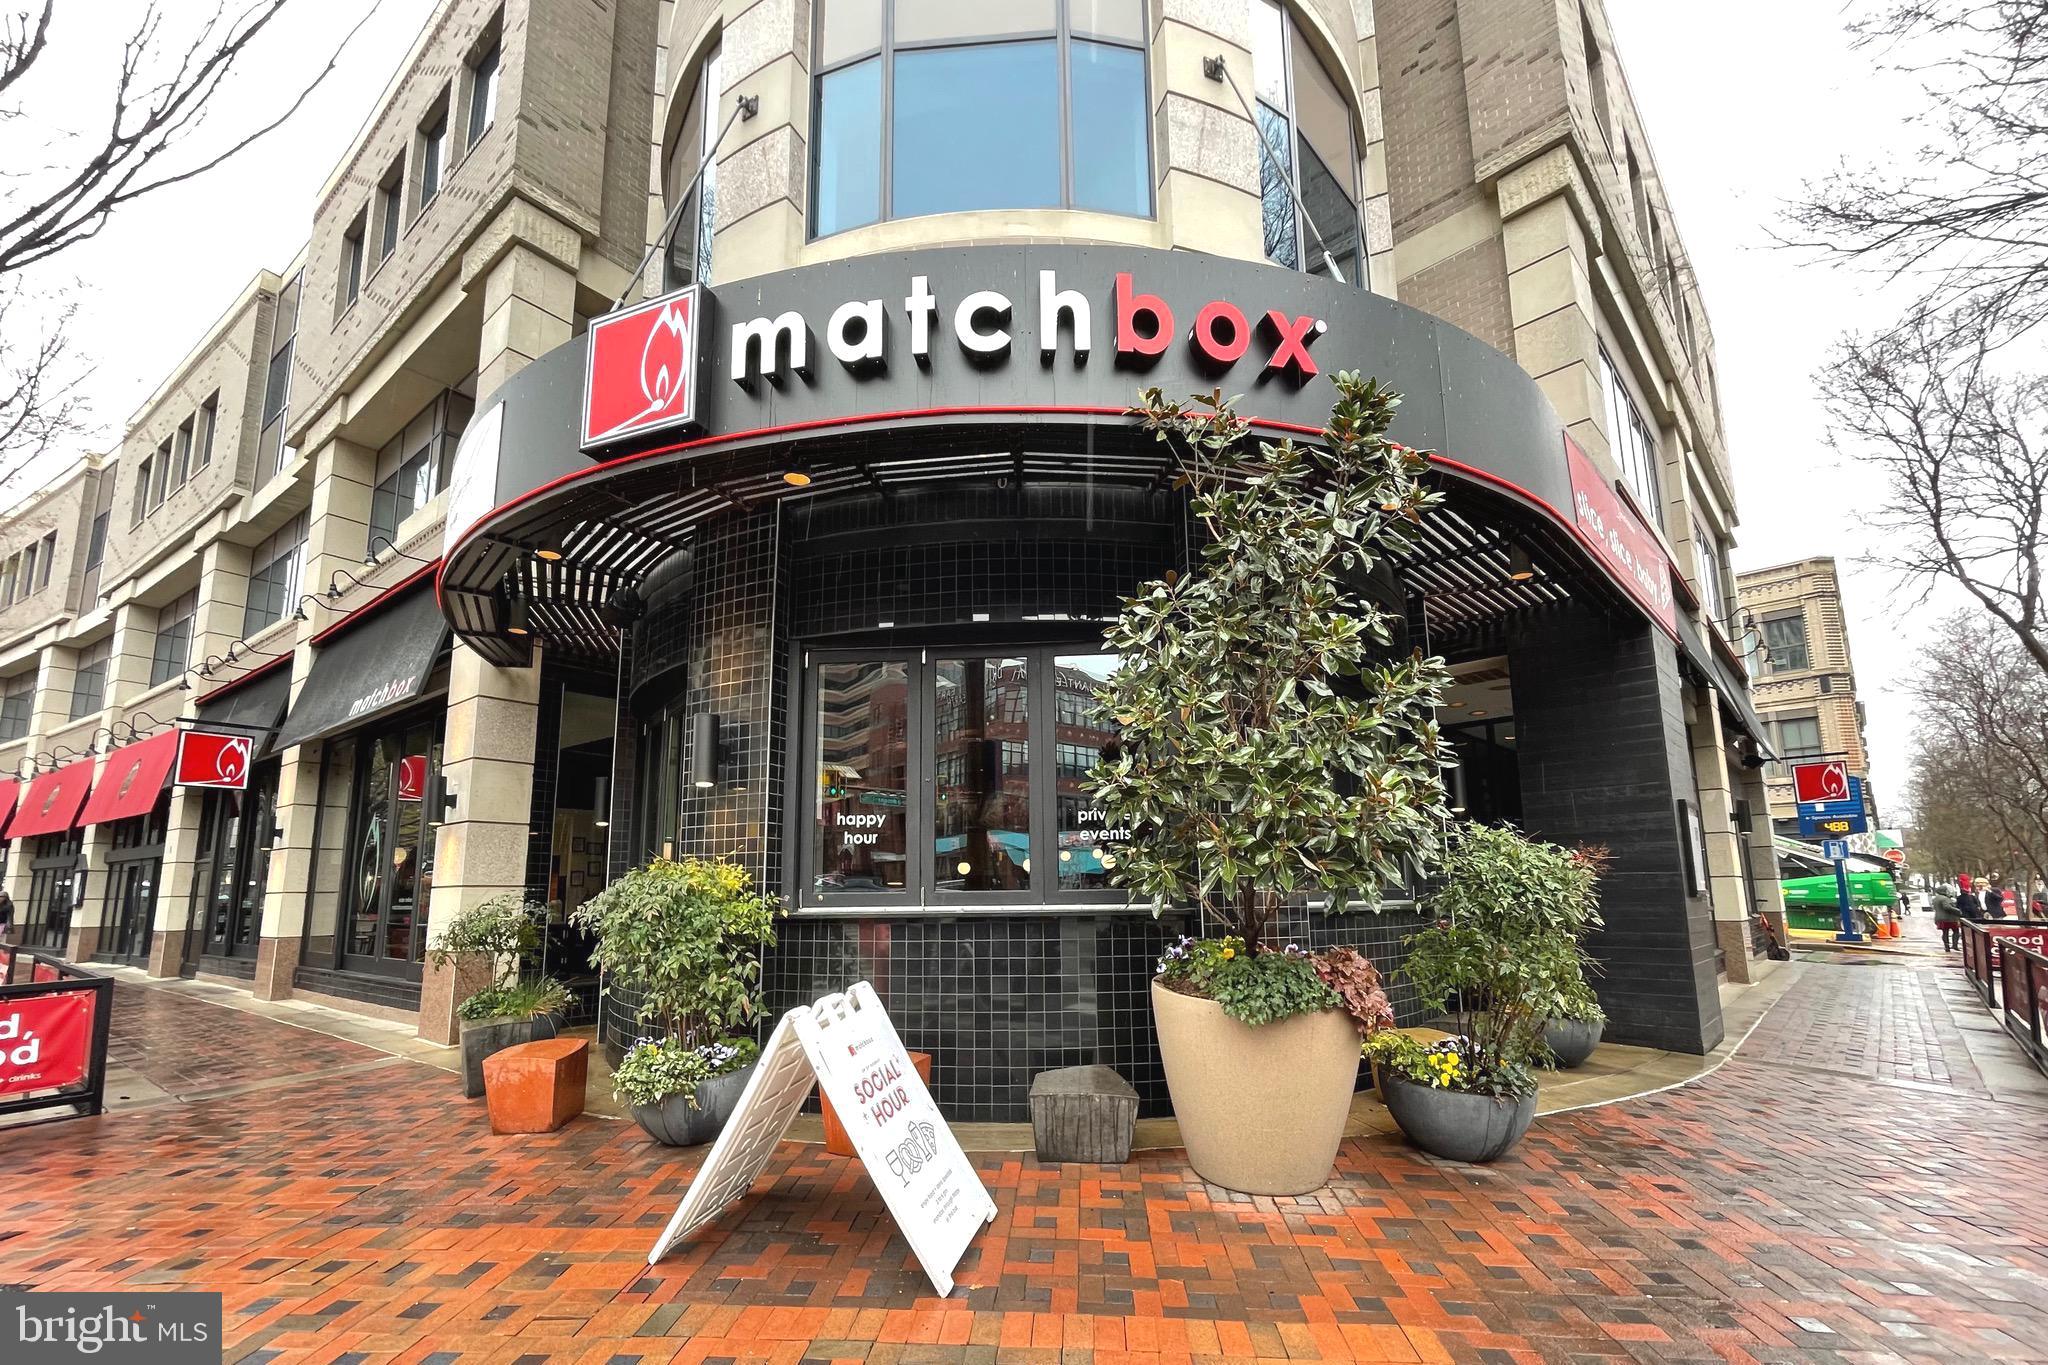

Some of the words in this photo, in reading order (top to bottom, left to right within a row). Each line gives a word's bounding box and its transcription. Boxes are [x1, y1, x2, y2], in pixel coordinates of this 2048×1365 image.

[731, 270, 1327, 384] matchbox
[348, 675, 417, 717] matchbox
[836, 812, 886, 828] happy
[1078, 808, 1131, 824] prive
[844, 831, 878, 844] hour
[1080, 826, 1132, 840] events
[854, 1059, 902, 1105] SOCIAL
[871, 1085, 910, 1128] HOUR
